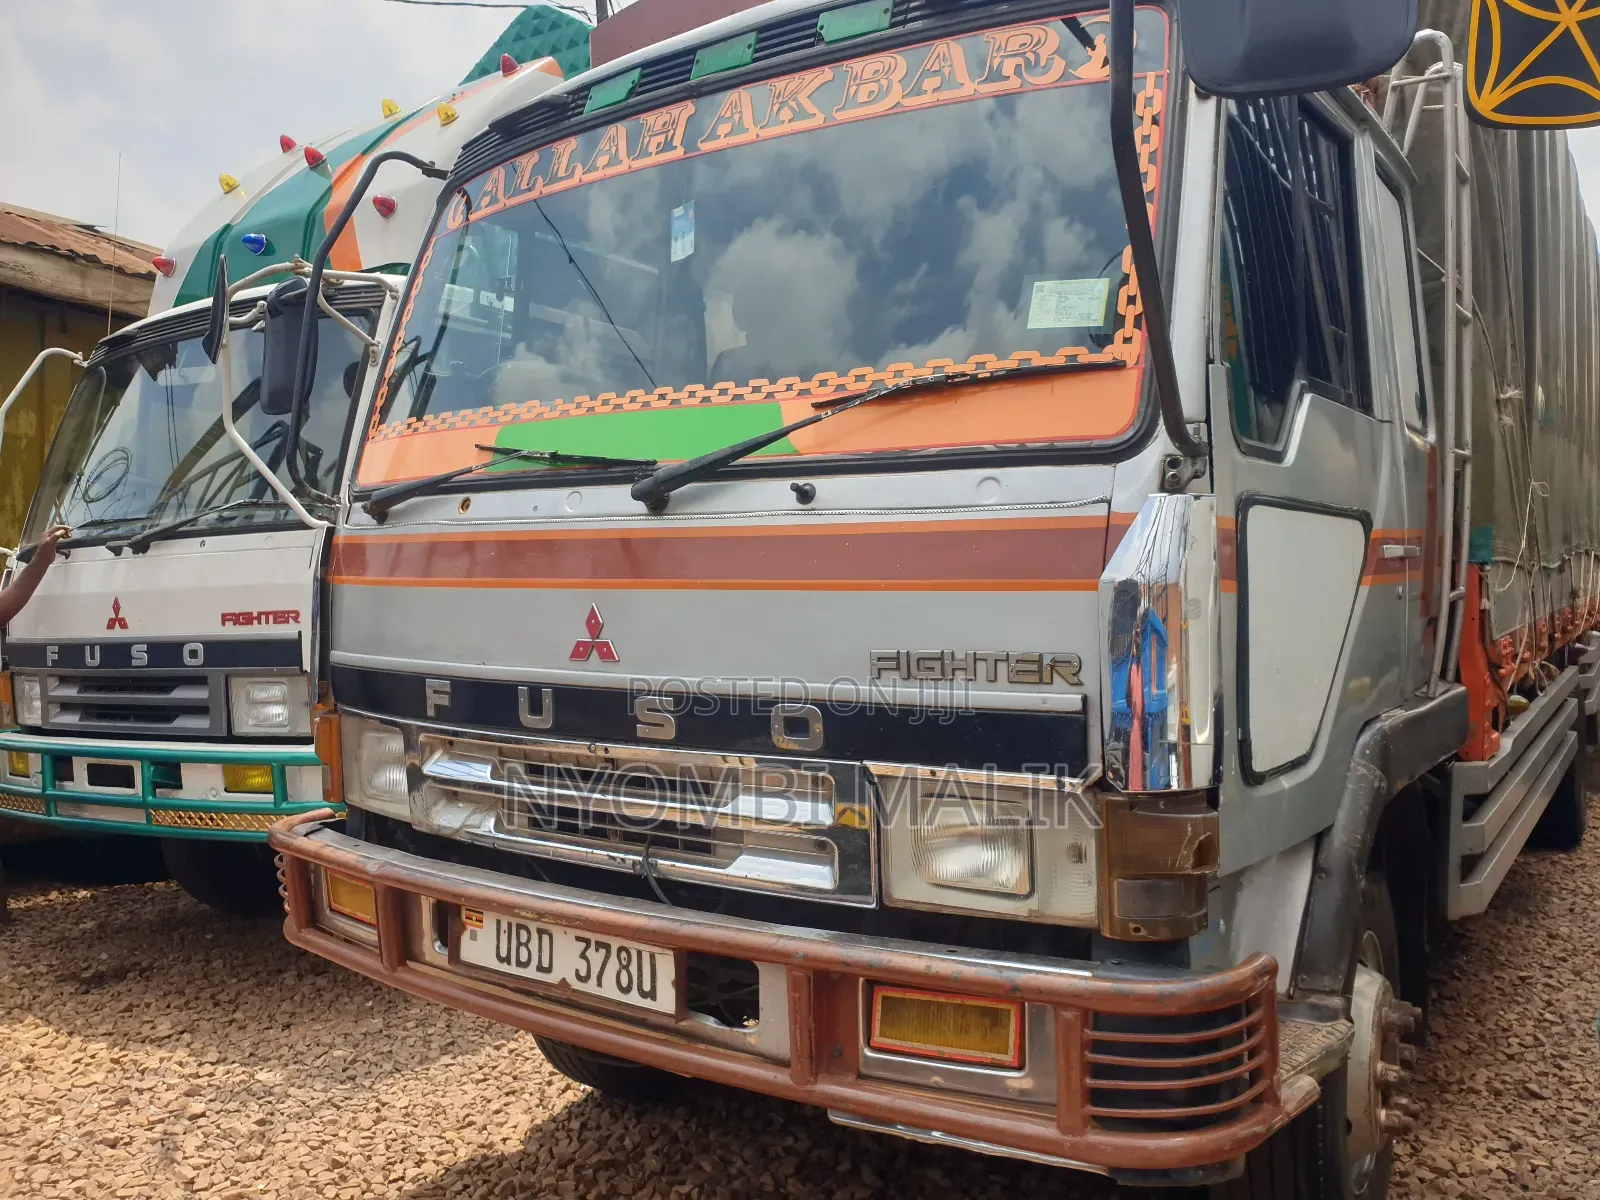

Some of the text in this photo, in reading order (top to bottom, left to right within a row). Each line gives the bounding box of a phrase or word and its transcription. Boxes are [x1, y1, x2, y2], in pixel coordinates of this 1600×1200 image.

[468, 24, 1067, 222] ALLAH AKBAR
[221, 609, 300, 626] FIGHTER
[46, 642, 204, 667] FUSO
[870, 650, 1085, 686] FIGHTER
[425, 678, 824, 751] FUSO
[495, 918, 658, 1002] UBD 378U
